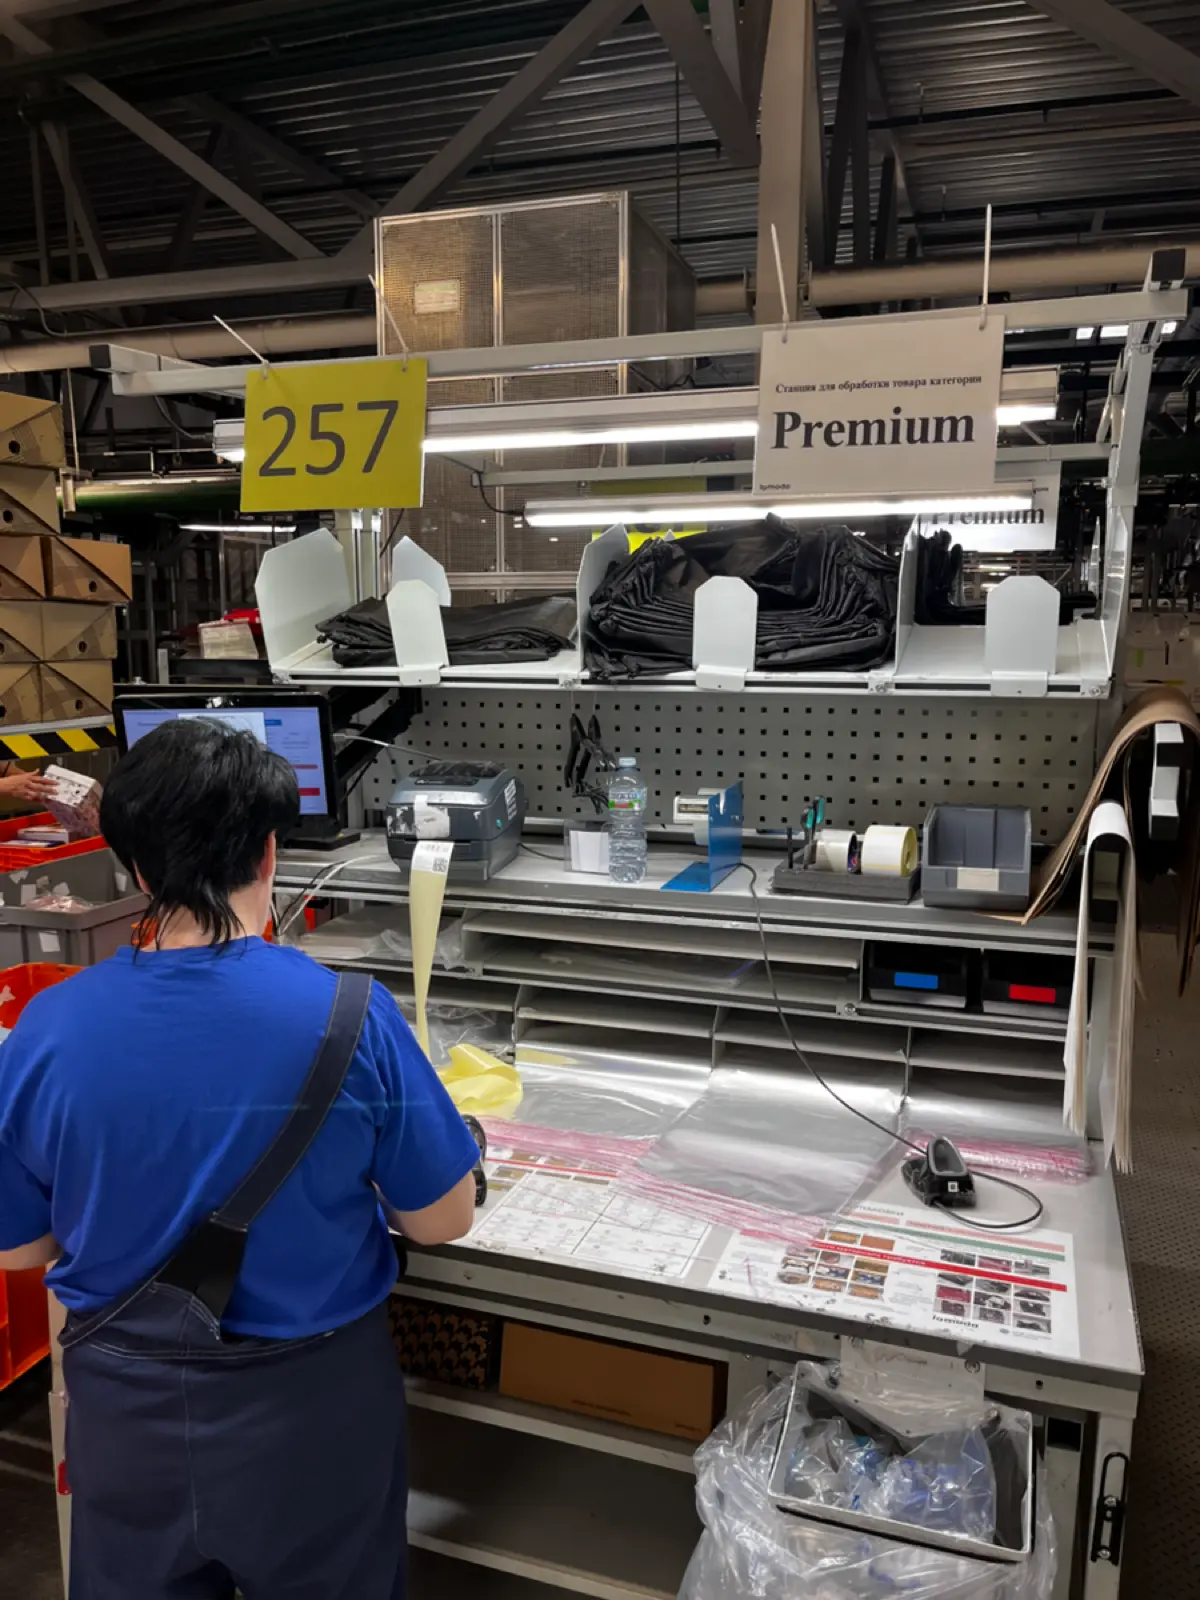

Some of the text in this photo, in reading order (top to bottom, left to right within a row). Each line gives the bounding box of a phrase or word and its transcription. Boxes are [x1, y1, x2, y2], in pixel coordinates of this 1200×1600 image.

[819, 383, 836, 391] для
[839, 380, 889, 392] обработки
[893, 379, 926, 389] товара
[929, 376, 981, 386] категории
[258, 400, 398, 477] 257
[771, 406, 975, 449] Premium
